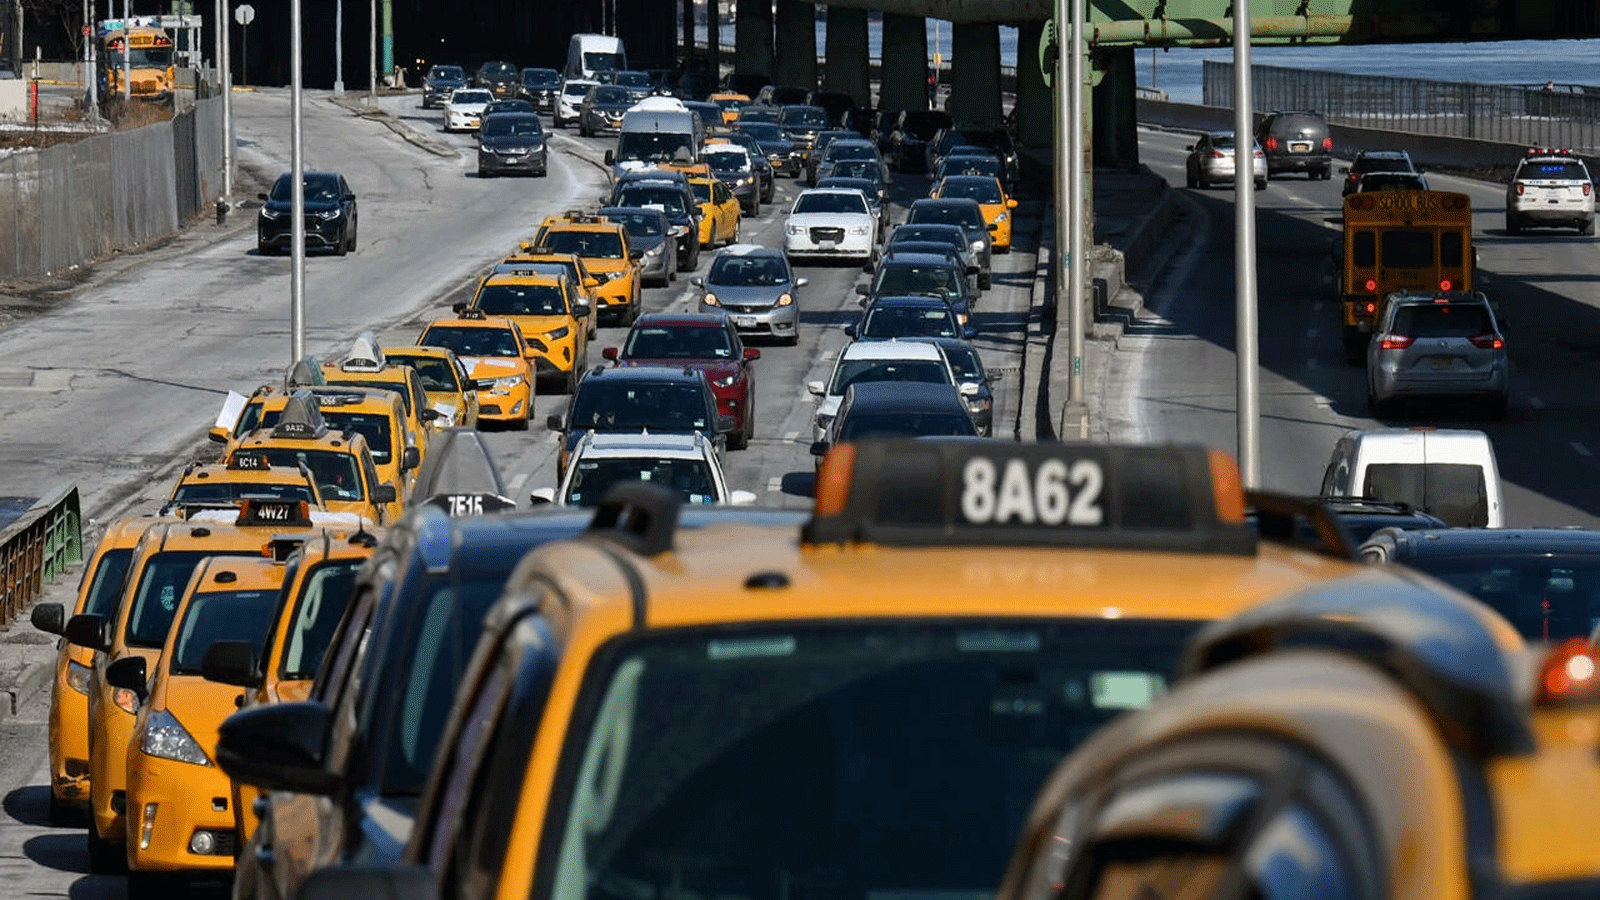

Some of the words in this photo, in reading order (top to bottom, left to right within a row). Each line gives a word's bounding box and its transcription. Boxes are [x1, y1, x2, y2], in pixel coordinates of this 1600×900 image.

[1379, 194, 1416, 211] SCHOOL
[1417, 194, 1437, 211] BUS
[285, 423, 304, 432] 9A32
[239, 457, 258, 468] 6C14
[961, 455, 1104, 525] 8A62
[257, 504, 289, 519] 4W27
